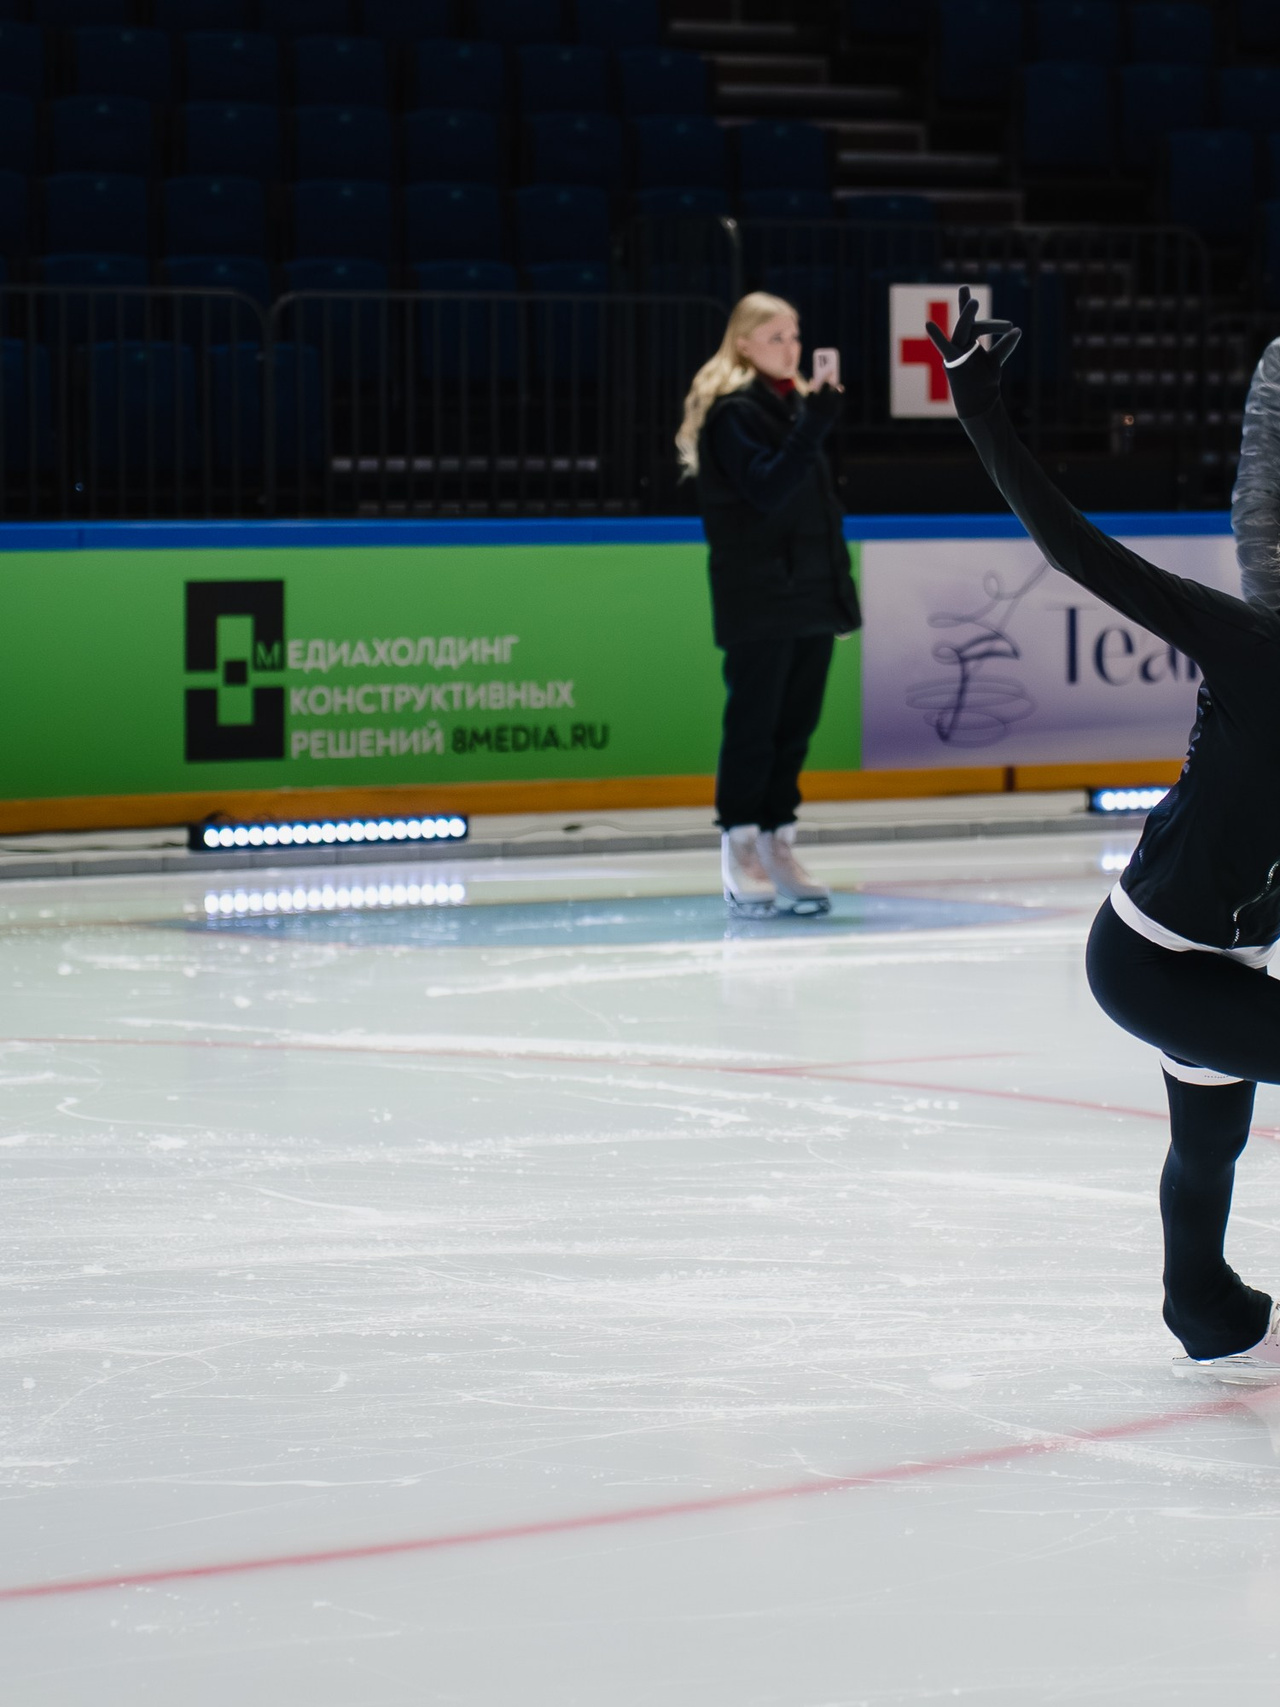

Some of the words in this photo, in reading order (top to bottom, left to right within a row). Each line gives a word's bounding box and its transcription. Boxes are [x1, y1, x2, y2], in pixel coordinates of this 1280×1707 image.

[252, 635, 520, 673] МЕДИАХОЛДИНГ
[1047, 605, 1199, 685] Tea
[289, 680, 575, 715] КОНСТРУКТИВНЫХ
[290, 720, 445, 759] РЕШЕНИЙ
[451, 723, 610, 754] 8MEDIA.RU
